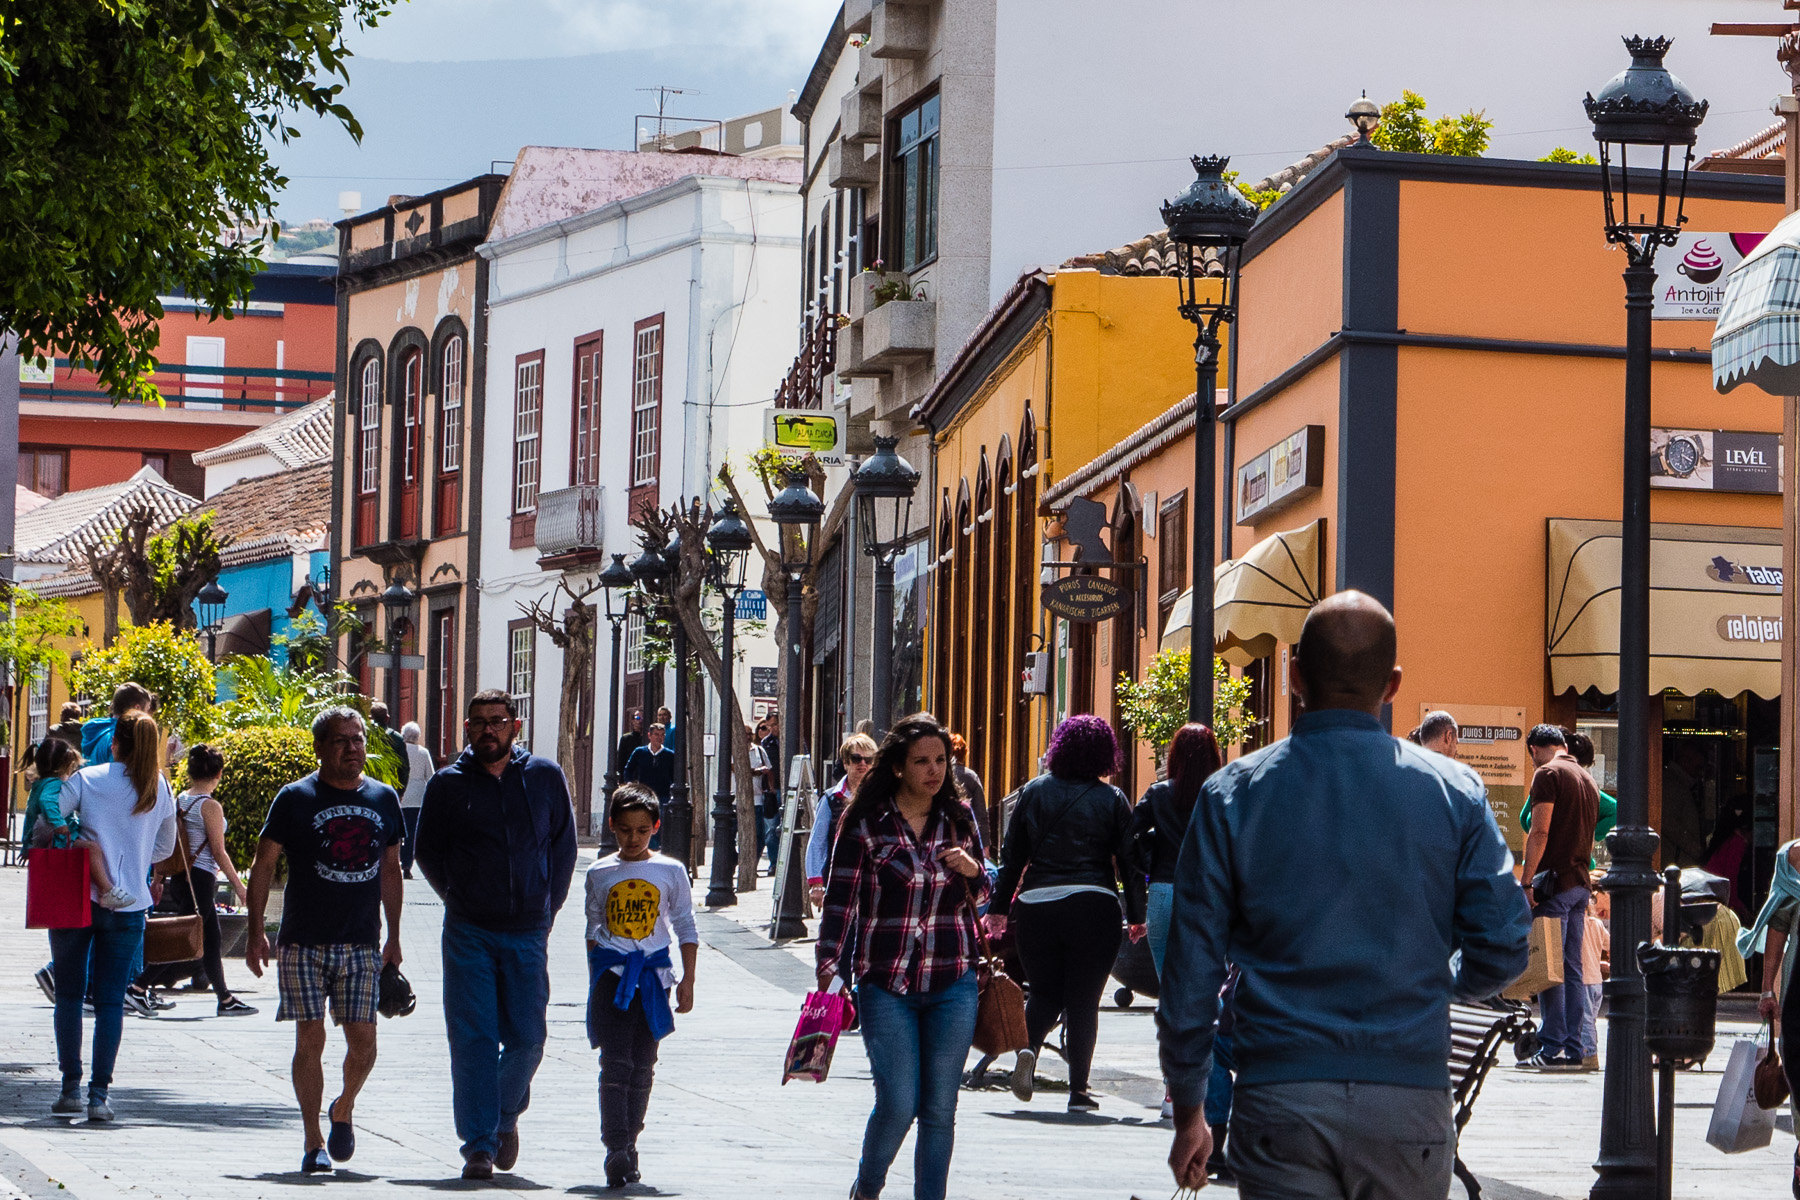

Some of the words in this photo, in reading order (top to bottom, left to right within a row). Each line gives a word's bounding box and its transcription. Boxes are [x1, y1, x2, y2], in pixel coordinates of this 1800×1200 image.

[1665, 285, 1725, 304] Antojit
[1702, 306, 1721, 314] Coff
[1725, 447, 1767, 465] LEVEL
[746, 591, 762, 599] Calle
[1059, 580, 1081, 593] PUROS
[1087, 580, 1118, 596] CANARIOS
[734, 609, 766, 619] ARBALLO
[1050, 599, 1085, 617] KANARISCHE
[1091, 602, 1119, 617] ZIGARREN
[1462, 727, 1482, 739] puros
[1485, 726, 1492, 738] la
[1494, 727, 1518, 740] palma
[320, 807, 378, 820] UNITED
[610, 899, 655, 913] PLANET
[617, 912, 648, 925] PIZZA
